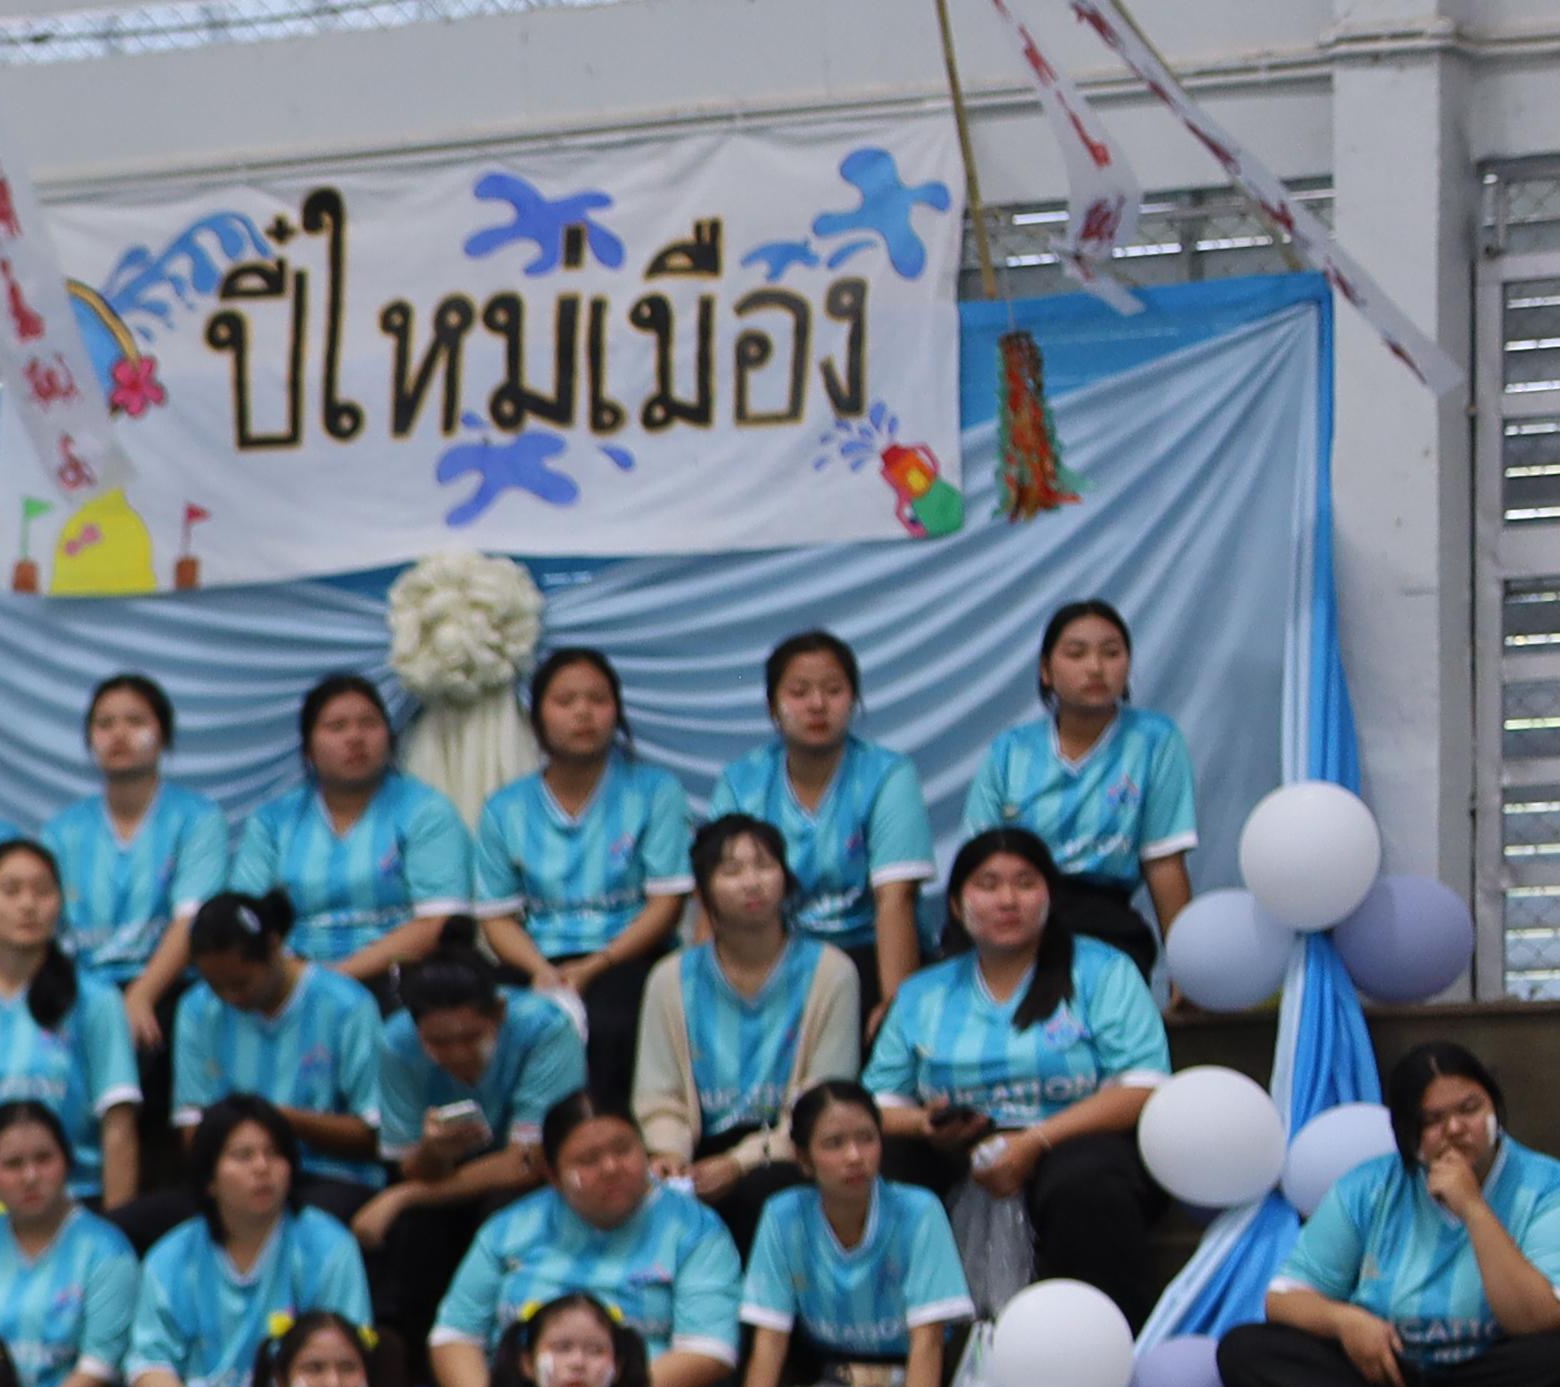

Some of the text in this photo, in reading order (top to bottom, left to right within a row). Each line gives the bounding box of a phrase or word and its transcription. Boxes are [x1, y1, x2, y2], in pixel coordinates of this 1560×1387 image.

[204, 186, 869, 450] ปี๋ใหม่เมือง
